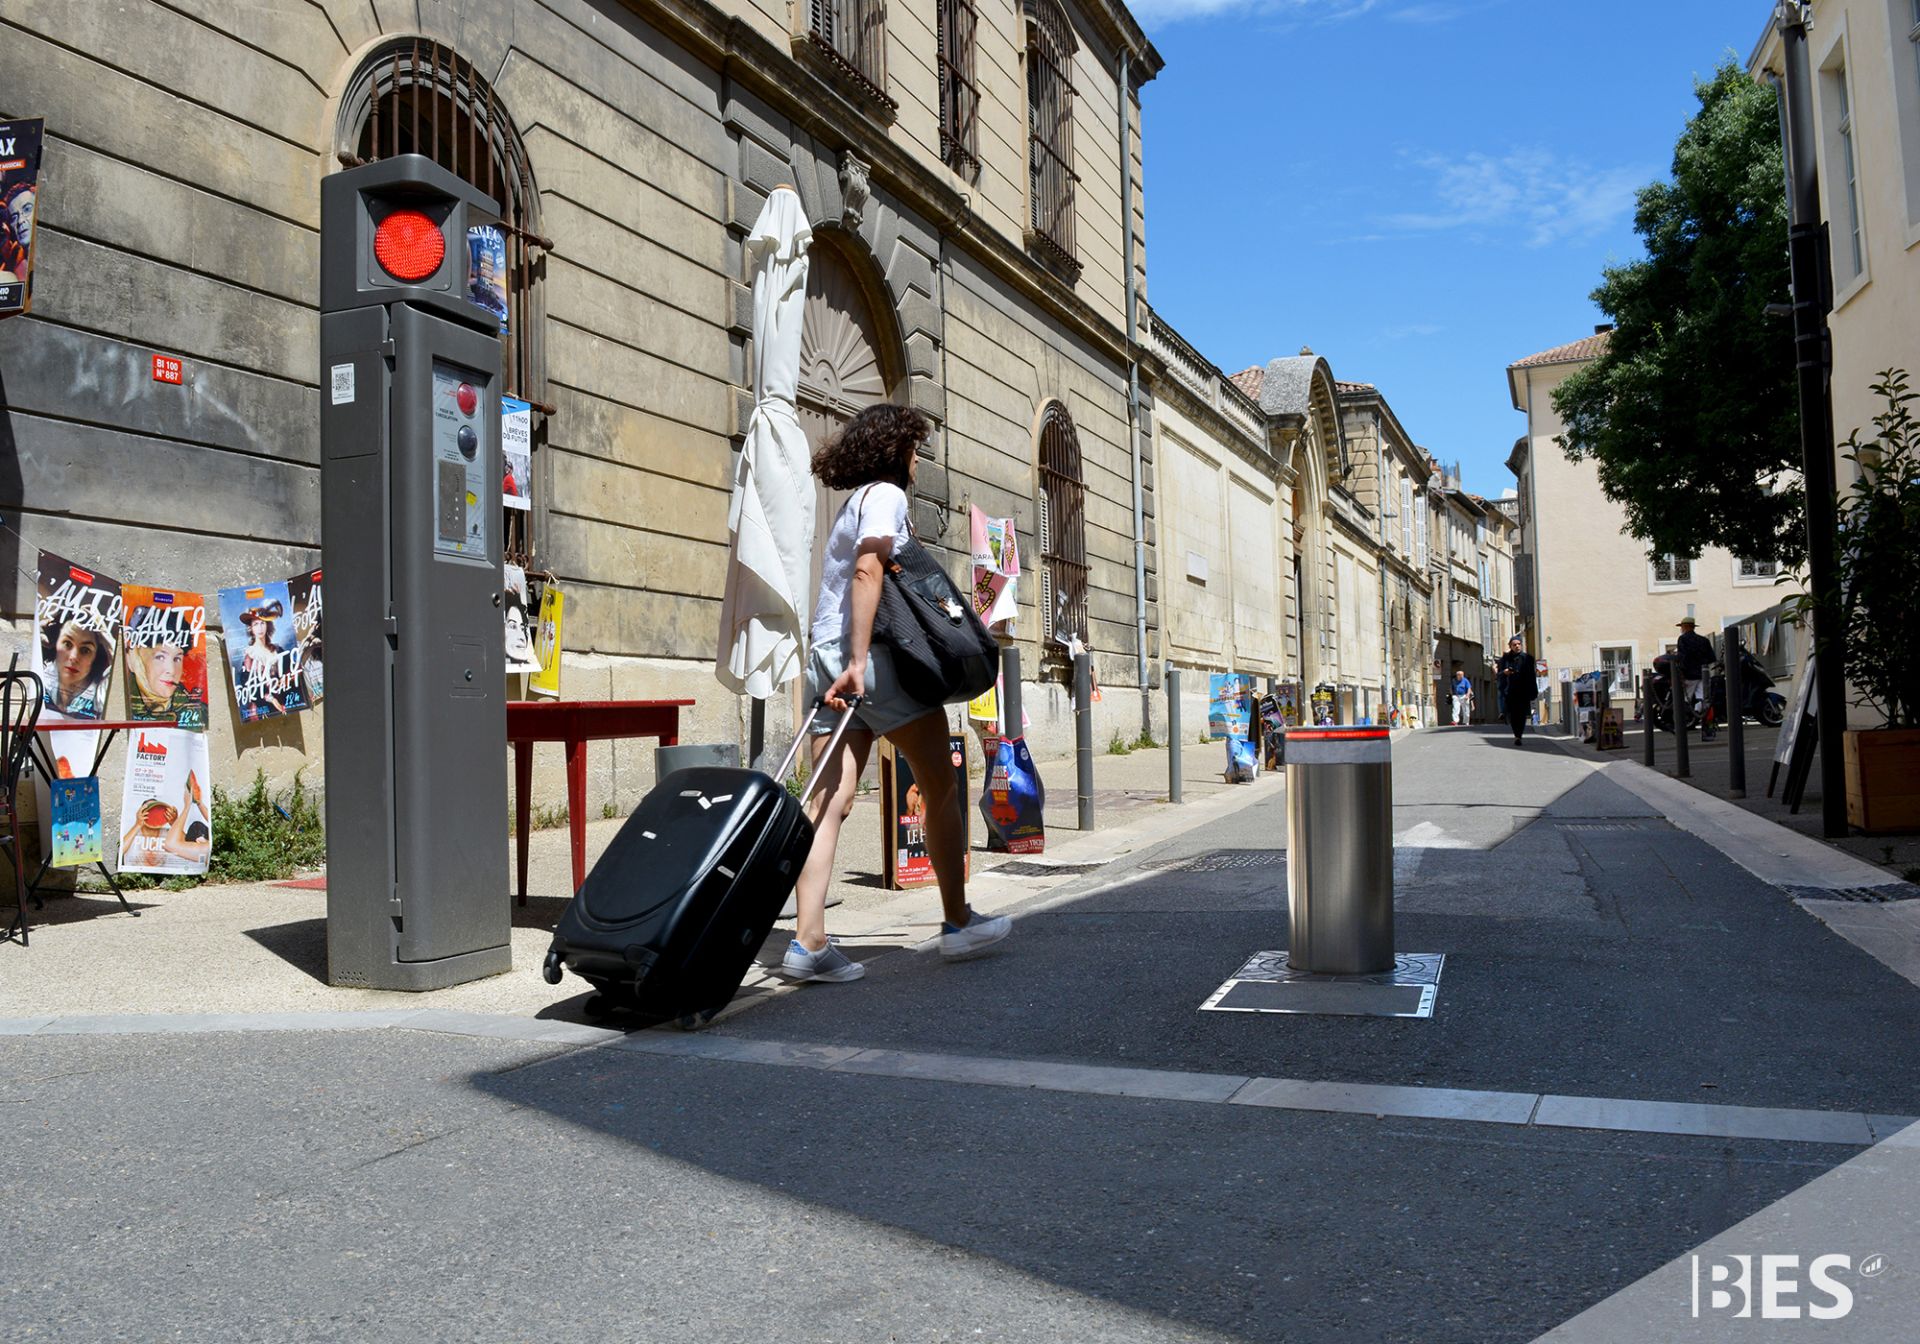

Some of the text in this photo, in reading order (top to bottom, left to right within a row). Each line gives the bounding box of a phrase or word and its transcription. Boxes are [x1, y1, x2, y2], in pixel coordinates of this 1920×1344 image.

[156, 359, 179, 371] BI 100
[165, 371, 179, 381] 887
[37, 598, 121, 634] ORTRAIT
[119, 604, 206, 635] L'AUTO
[122, 628, 206, 649] PORTRAIT
[232, 646, 302, 688] L'AUTO
[234, 667, 304, 708] PORTRAIT
[136, 753, 166, 762] FACTORY
